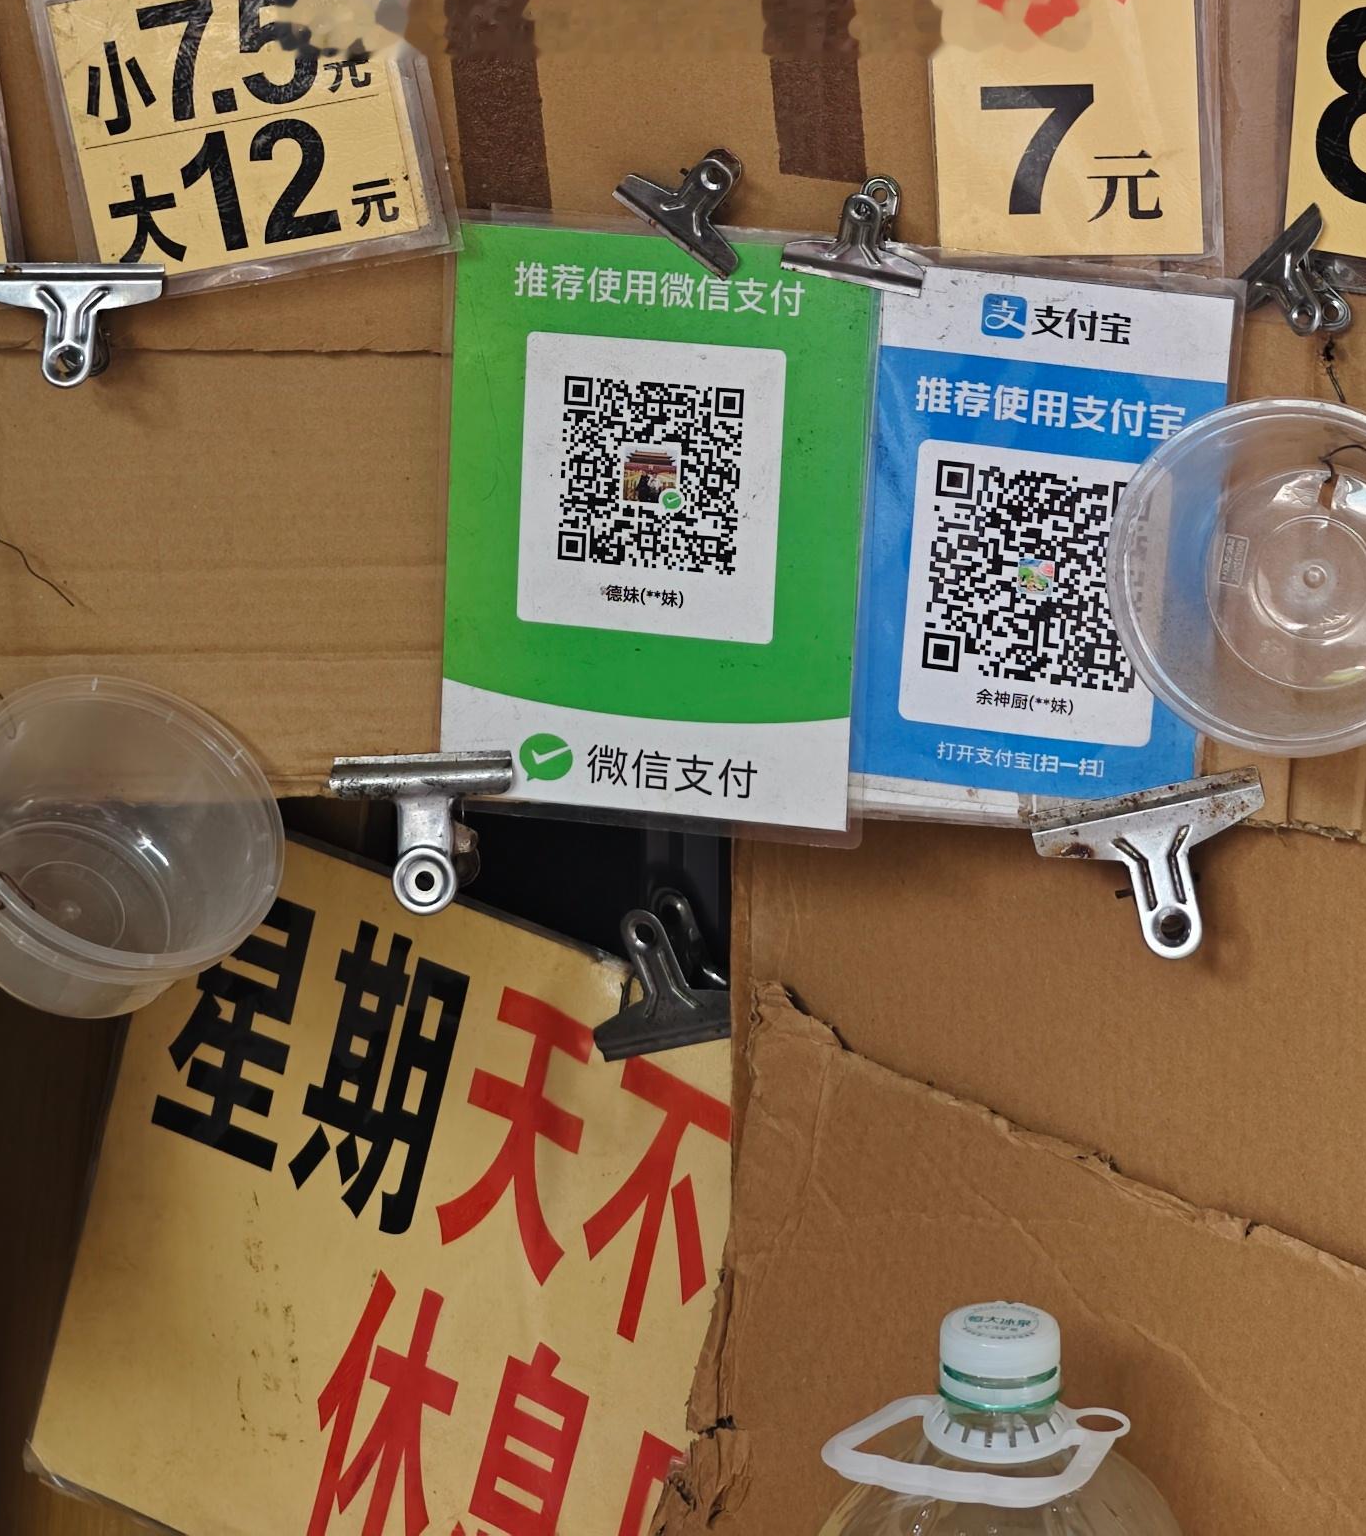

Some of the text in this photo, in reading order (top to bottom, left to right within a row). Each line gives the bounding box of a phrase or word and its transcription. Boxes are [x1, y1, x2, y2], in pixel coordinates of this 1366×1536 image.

[979, 83, 1164, 222] 7元
[107, 119, 401, 263] 大12元
[514, 260, 806, 317] 推荐使用微信支付
[1031, 305, 1132, 346] 支付宝
[914, 375, 1187, 441] 推荐使用支付宝
[585, 742, 759, 800] 微信支付
[150, 896, 732, 1344] 星期天不
